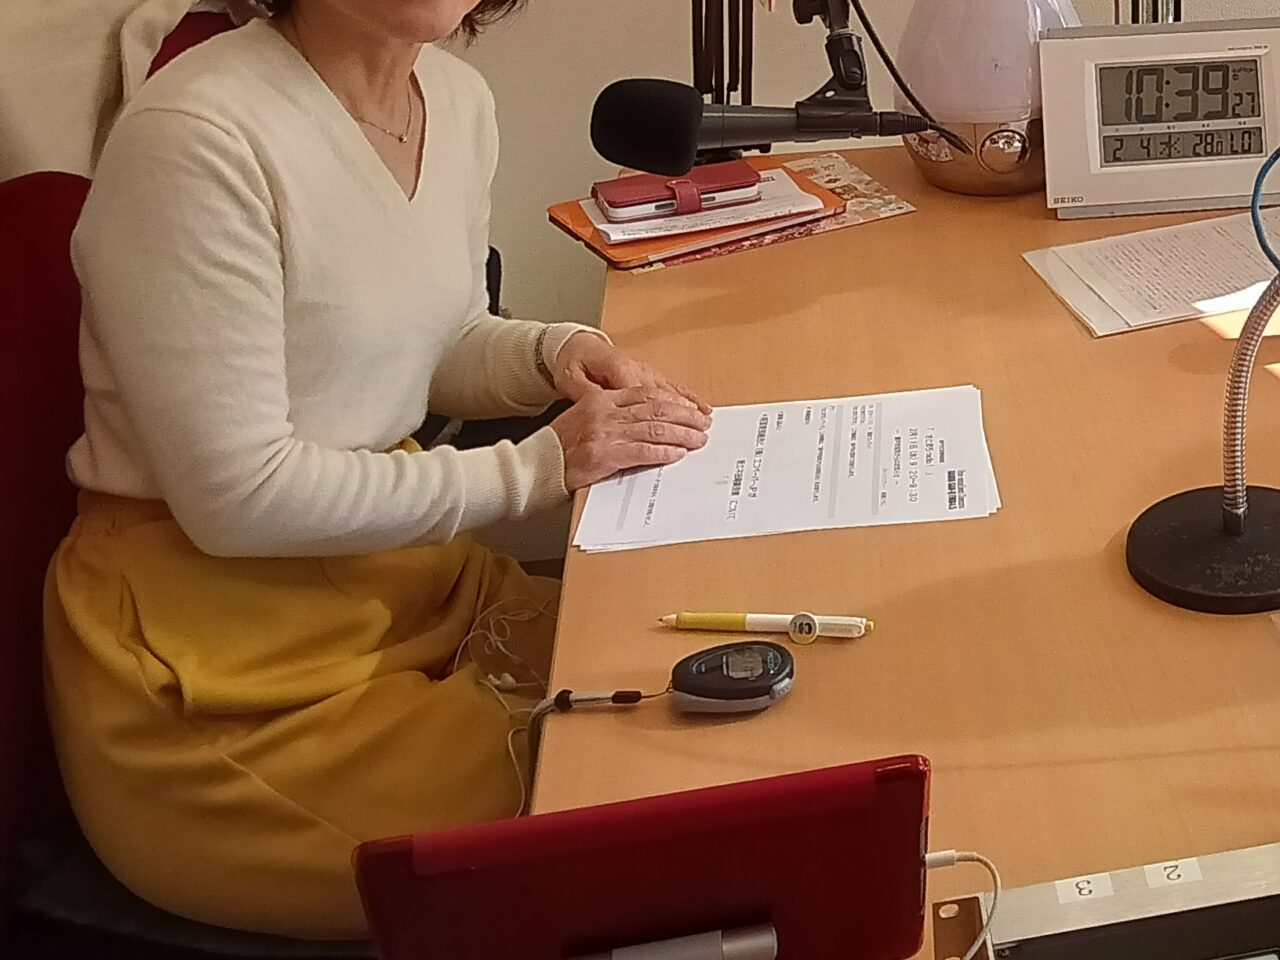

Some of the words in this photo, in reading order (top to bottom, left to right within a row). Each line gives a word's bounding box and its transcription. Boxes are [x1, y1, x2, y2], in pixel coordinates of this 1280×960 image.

[1124, 64, 1229, 122] 10:39
[1232, 91, 1255, 117] 27
[1113, 138, 1124, 161] 2
[1140, 136, 1151, 158] 4
[1160, 134, 1181, 159] 水
[1054, 196, 1084, 204] SEIKO
[1163, 865, 1181, 881] 2
[1074, 879, 1092, 897] 3
